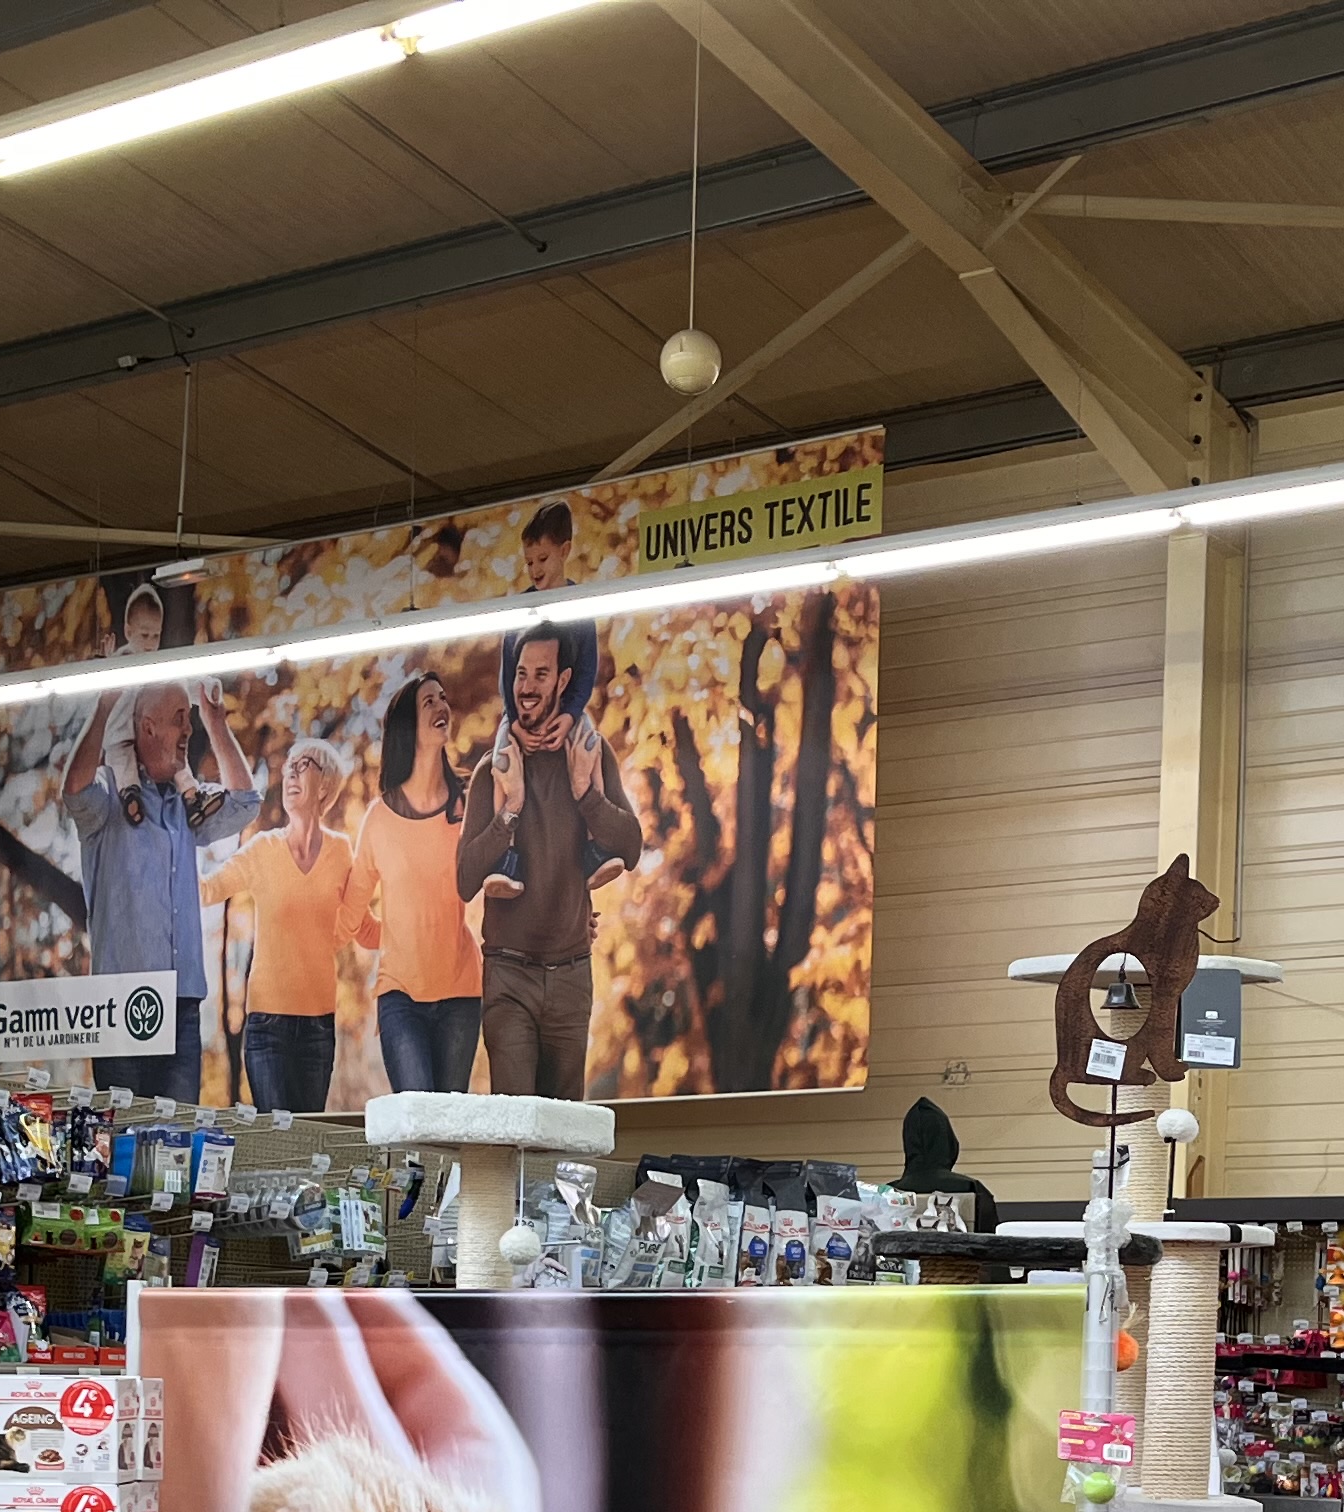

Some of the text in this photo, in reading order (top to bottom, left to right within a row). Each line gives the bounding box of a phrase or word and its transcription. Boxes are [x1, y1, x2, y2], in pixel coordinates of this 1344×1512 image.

[646, 483, 873, 561] UNIVERS TEXTILE
[65, 998, 117, 1030] vert
[23, 1035, 34, 1047] DE
[36, 1034, 46, 1046] LA
[48, 1032, 100, 1046] JARDINERIE
[11, 1412, 55, 1425] AGEING
